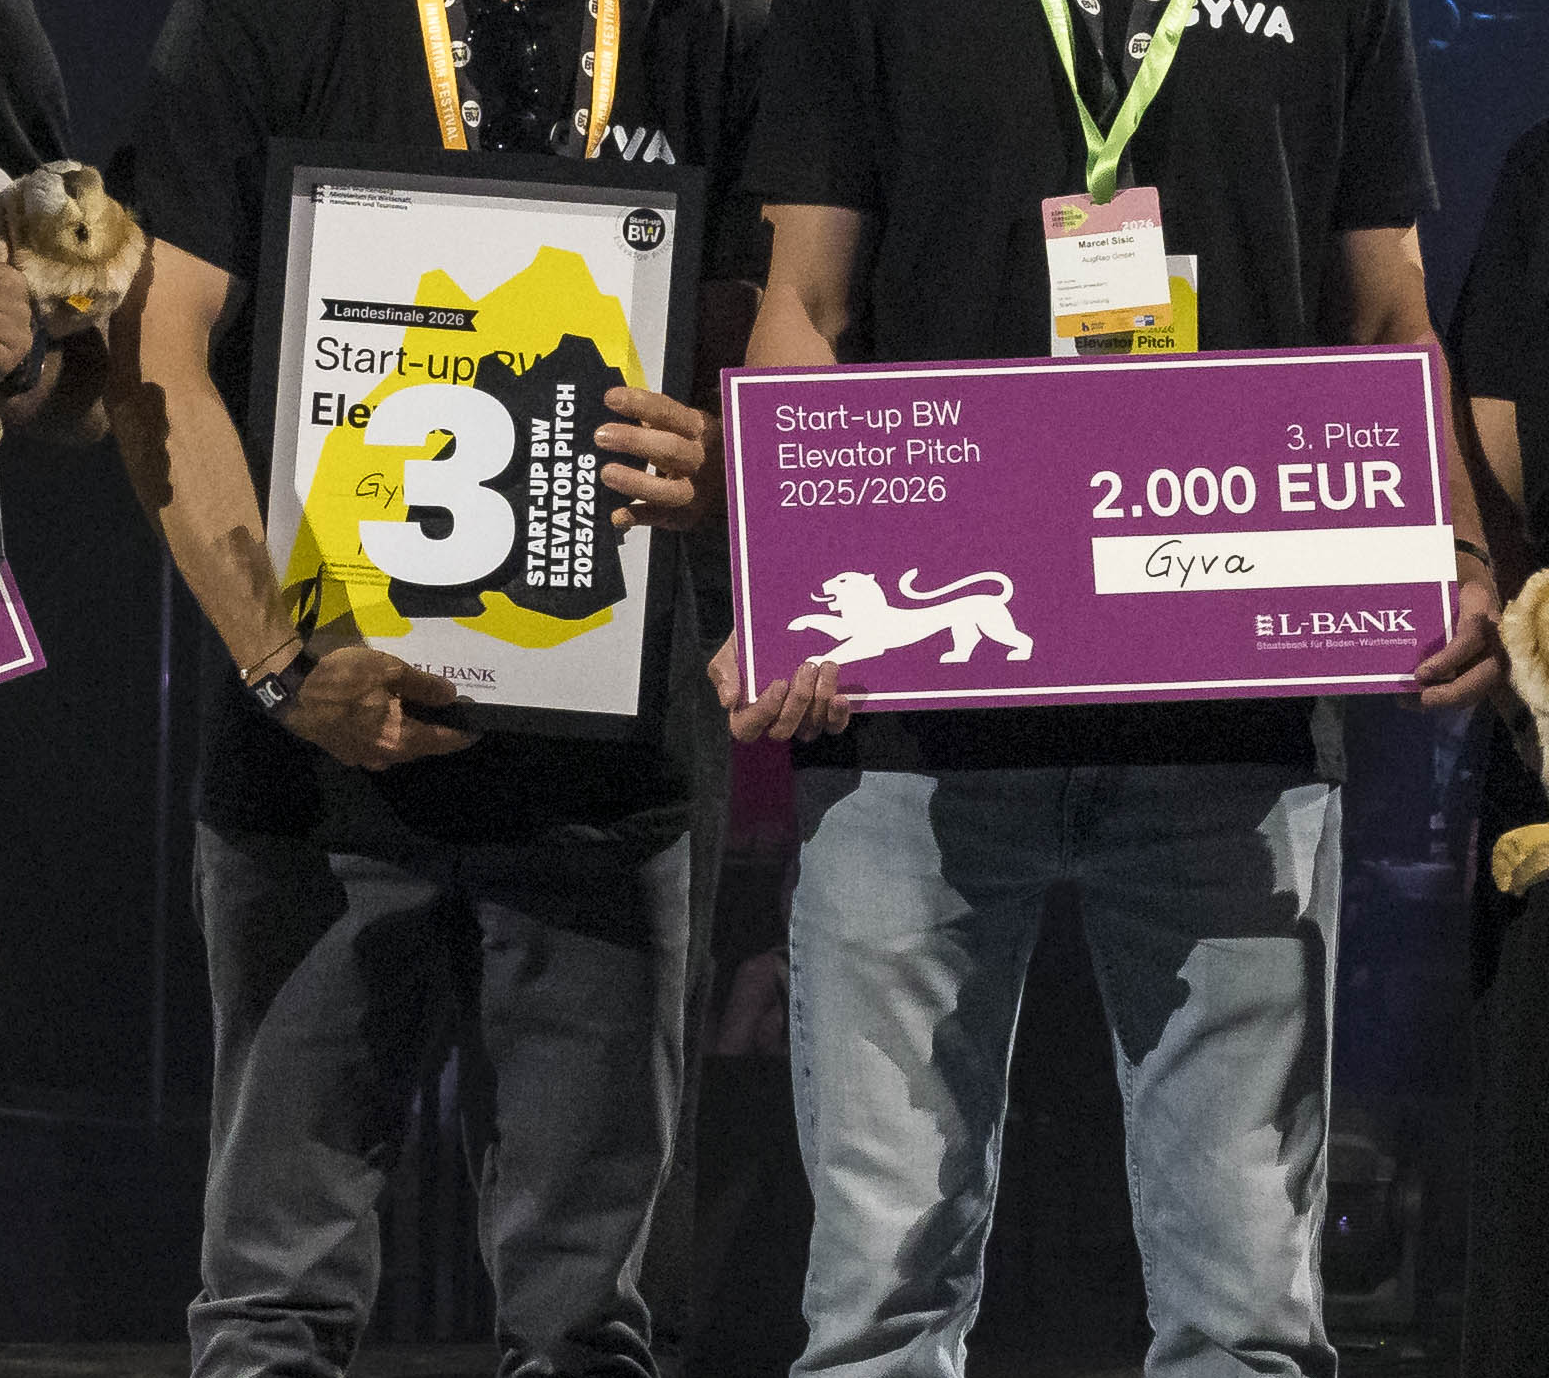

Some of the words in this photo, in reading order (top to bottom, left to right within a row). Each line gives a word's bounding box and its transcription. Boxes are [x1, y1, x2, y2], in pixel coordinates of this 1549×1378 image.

[627, 224, 661, 243] BW
[629, 216, 662, 227] Start-up
[1121, 219, 1155, 232] 2026
[1078, 238, 1110, 249] Marcel
[333, 304, 425, 323] Landesfinale
[428, 311, 465, 327] 2026
[1137, 335, 1175, 349] Pitch
[314, 336, 476, 386] Start-up
[554, 384, 576, 457] PITCH
[775, 404, 902, 434] Start-up
[912, 399, 961, 427] BW
[531, 418, 551, 458] BW
[1286, 424, 1313, 450] 3.
[1325, 422, 1400, 449] Platz
[778, 441, 897, 469] Elevator
[906, 437, 981, 465] Pitch
[359, 383, 517, 587] 3
[779, 476, 947, 507] 2025/2026
[1089, 465, 1257, 519] 2.000
[1277, 460, 1406, 512] EUR
[526, 462, 549, 587] START-UP
[550, 462, 573, 587] ELEVATOR
[573, 453, 596, 588] 2025/2026
[1145, 539, 1255, 589] Gyva
[1277, 609, 1417, 636] L-BANK
[1310, 639, 1323, 648] für
[1325, 636, 1418, 648] Baden-Württemberg
